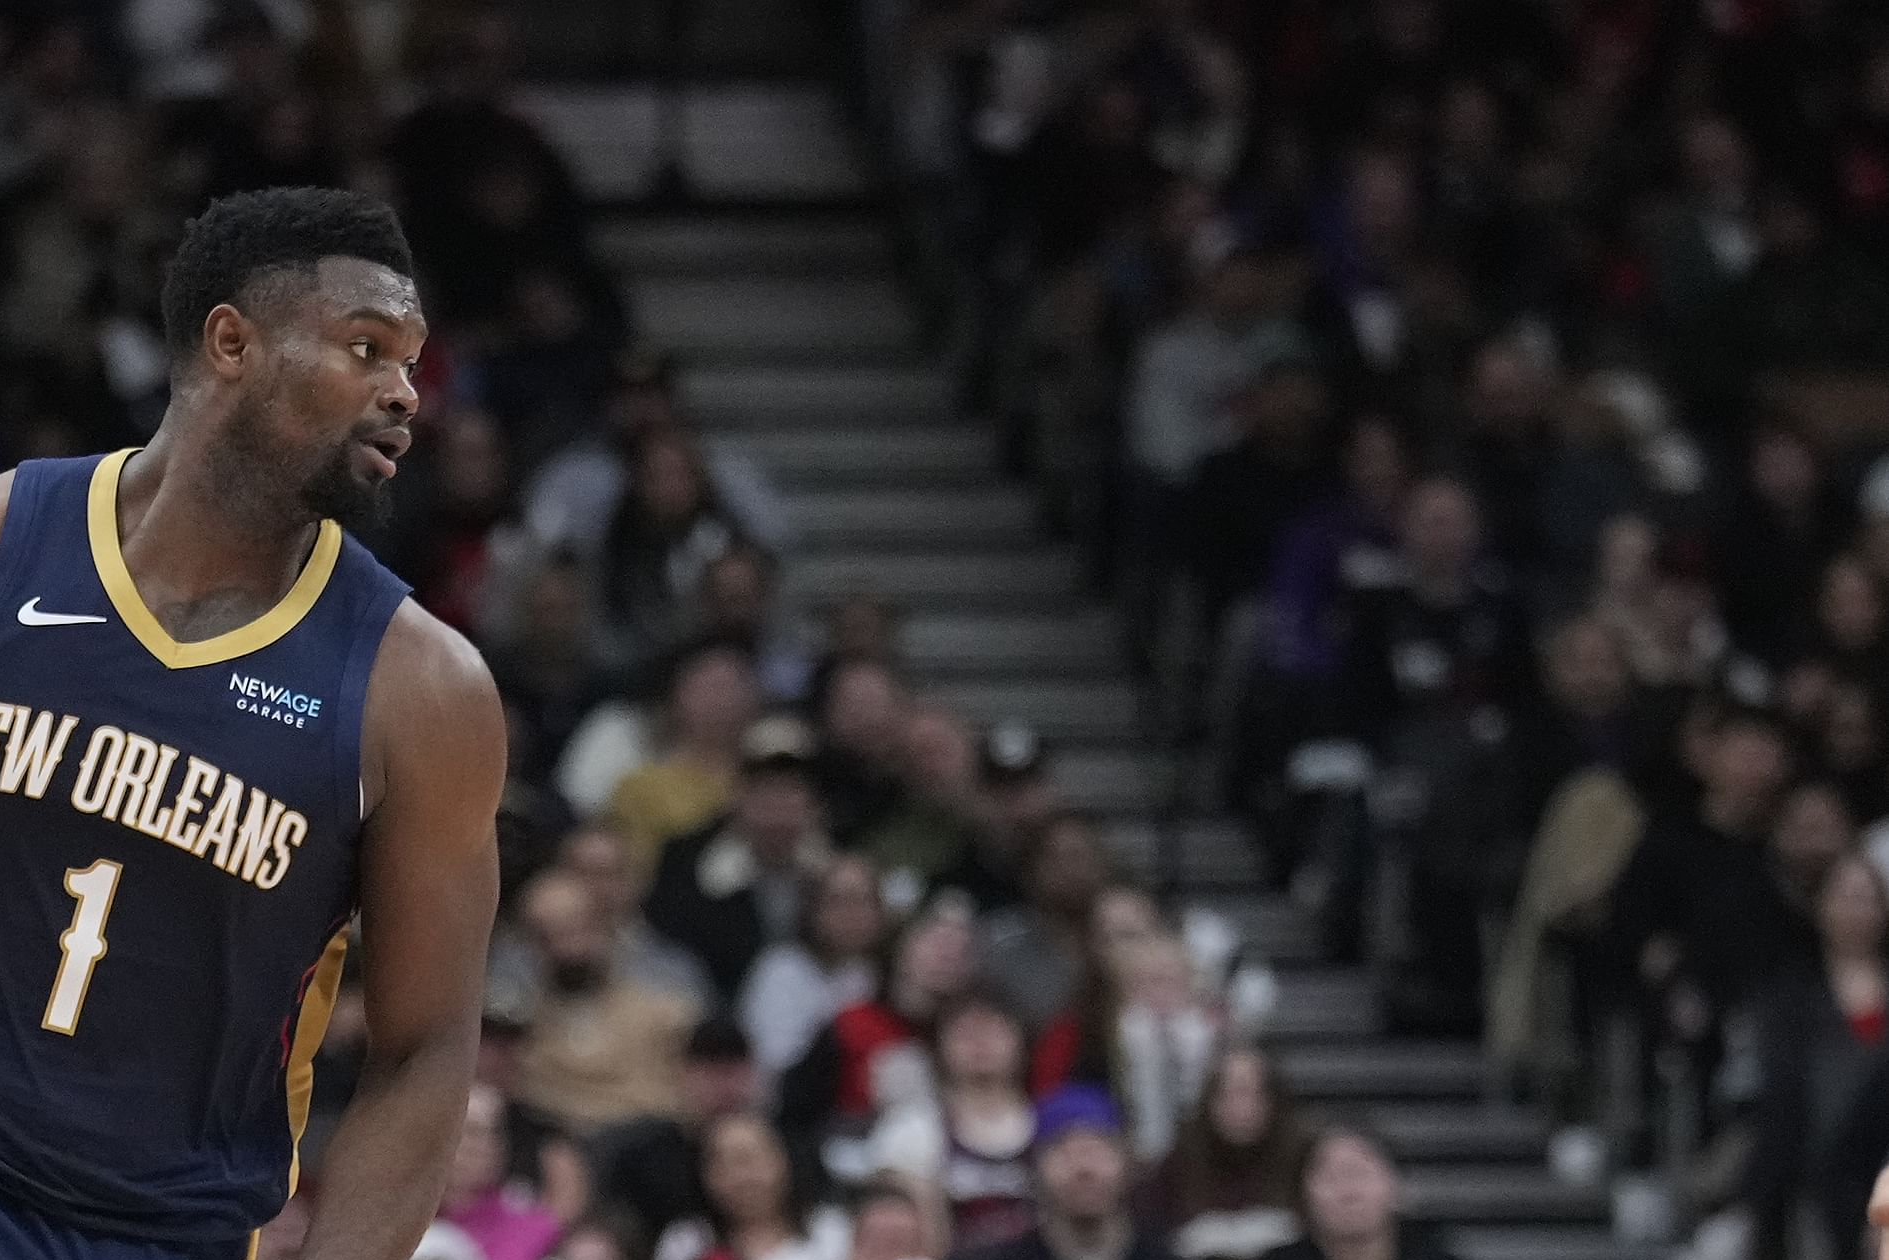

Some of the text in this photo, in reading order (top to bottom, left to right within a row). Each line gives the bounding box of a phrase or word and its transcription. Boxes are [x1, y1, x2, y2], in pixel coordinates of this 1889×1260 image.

[229, 672, 322, 717] NEWAGE
[236, 699, 305, 729] GARAGE
[71, 725, 308, 890] ORLEANS
[41, 858, 124, 1037] 1
